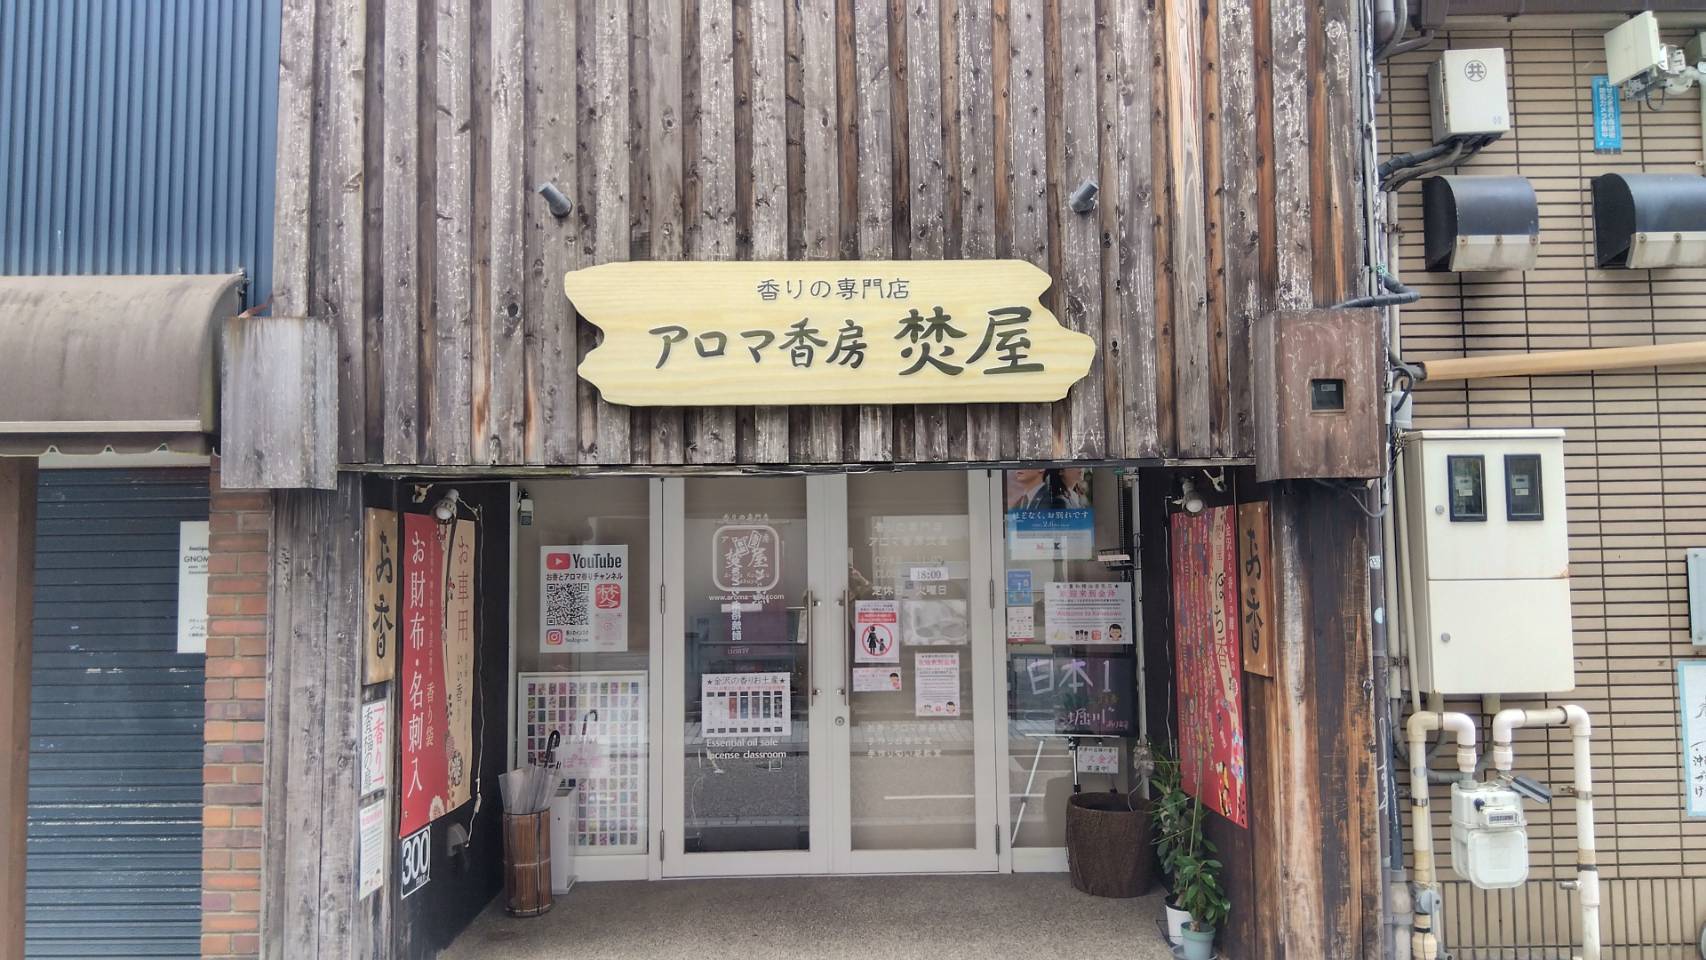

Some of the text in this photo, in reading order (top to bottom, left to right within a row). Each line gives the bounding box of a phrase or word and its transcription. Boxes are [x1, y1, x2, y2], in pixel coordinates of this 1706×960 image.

[756, 278, 911, 300] 香りの専門店
[648, 305, 1046, 377] アロマ香房 焚屋
[572, 553, 622, 569] YouTube
[372, 530, 394, 659] お香
[1245, 527, 1265, 654] お香
[407, 530, 427, 799] お財布・名刺入
[706, 738, 779, 748] Essential oil sale
[743, 750, 787, 759] classroom
[402, 829, 429, 886] 300
